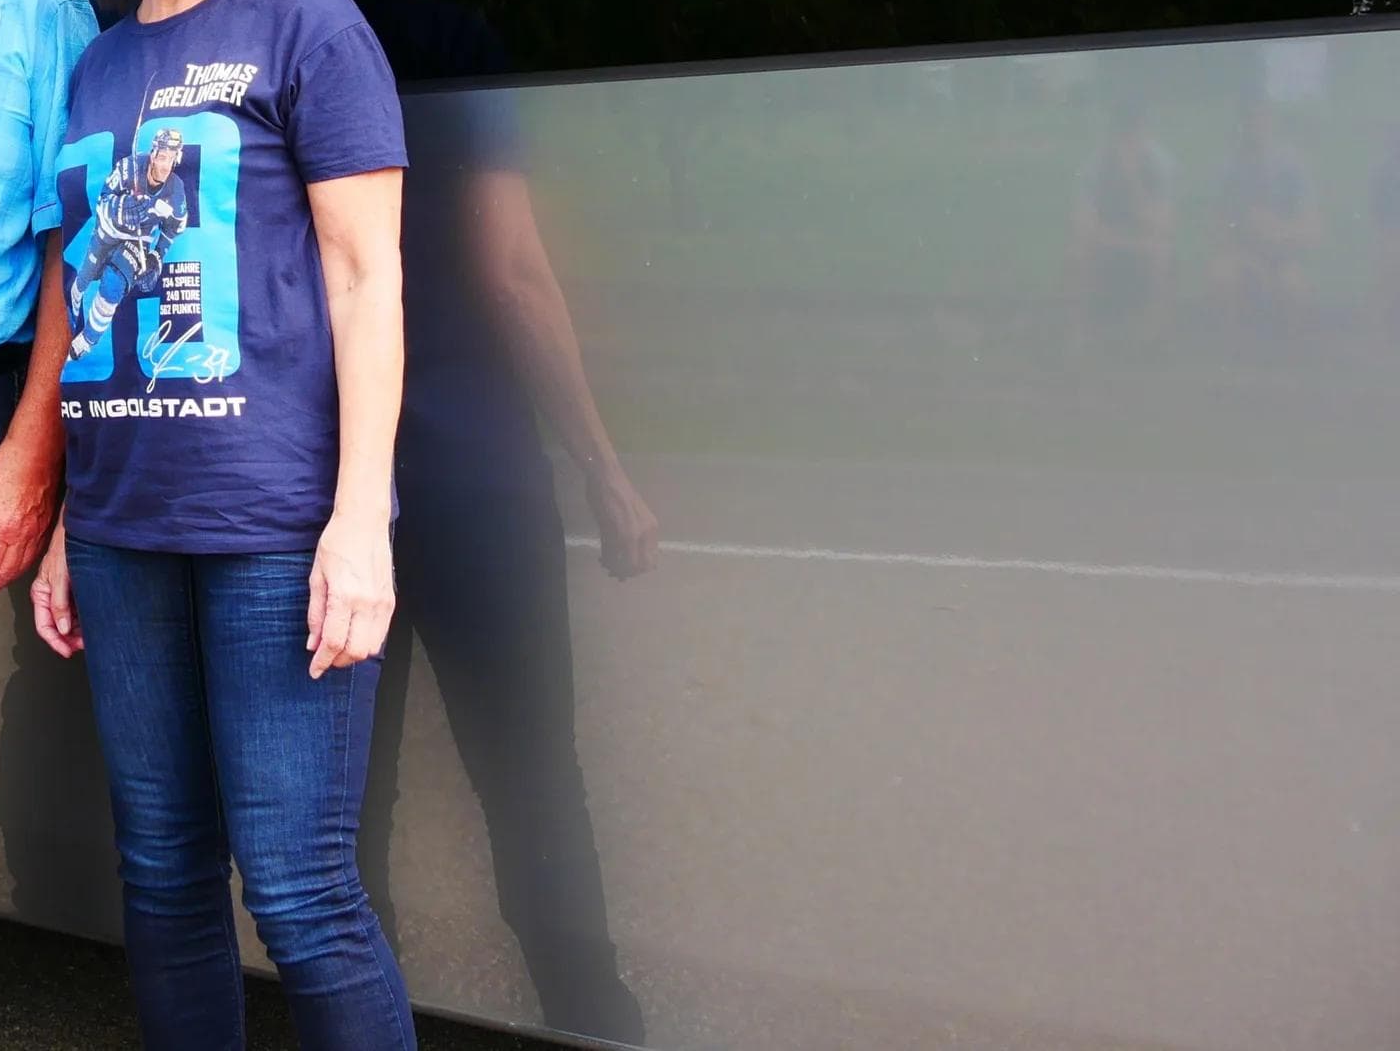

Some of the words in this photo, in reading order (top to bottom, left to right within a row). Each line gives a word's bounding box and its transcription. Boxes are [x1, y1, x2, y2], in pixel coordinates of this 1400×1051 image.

[184, 63, 258, 86] THOMAS
[149, 81, 248, 110] GREILINGER
[175, 263, 200, 274] JAHRE
[175, 276, 200, 287] SPIELE
[180, 289, 200, 301] TORE
[172, 303, 201, 315] PUNKTE
[61, 401, 82, 418] RC
[89, 397, 246, 418] INGOLSTADT
